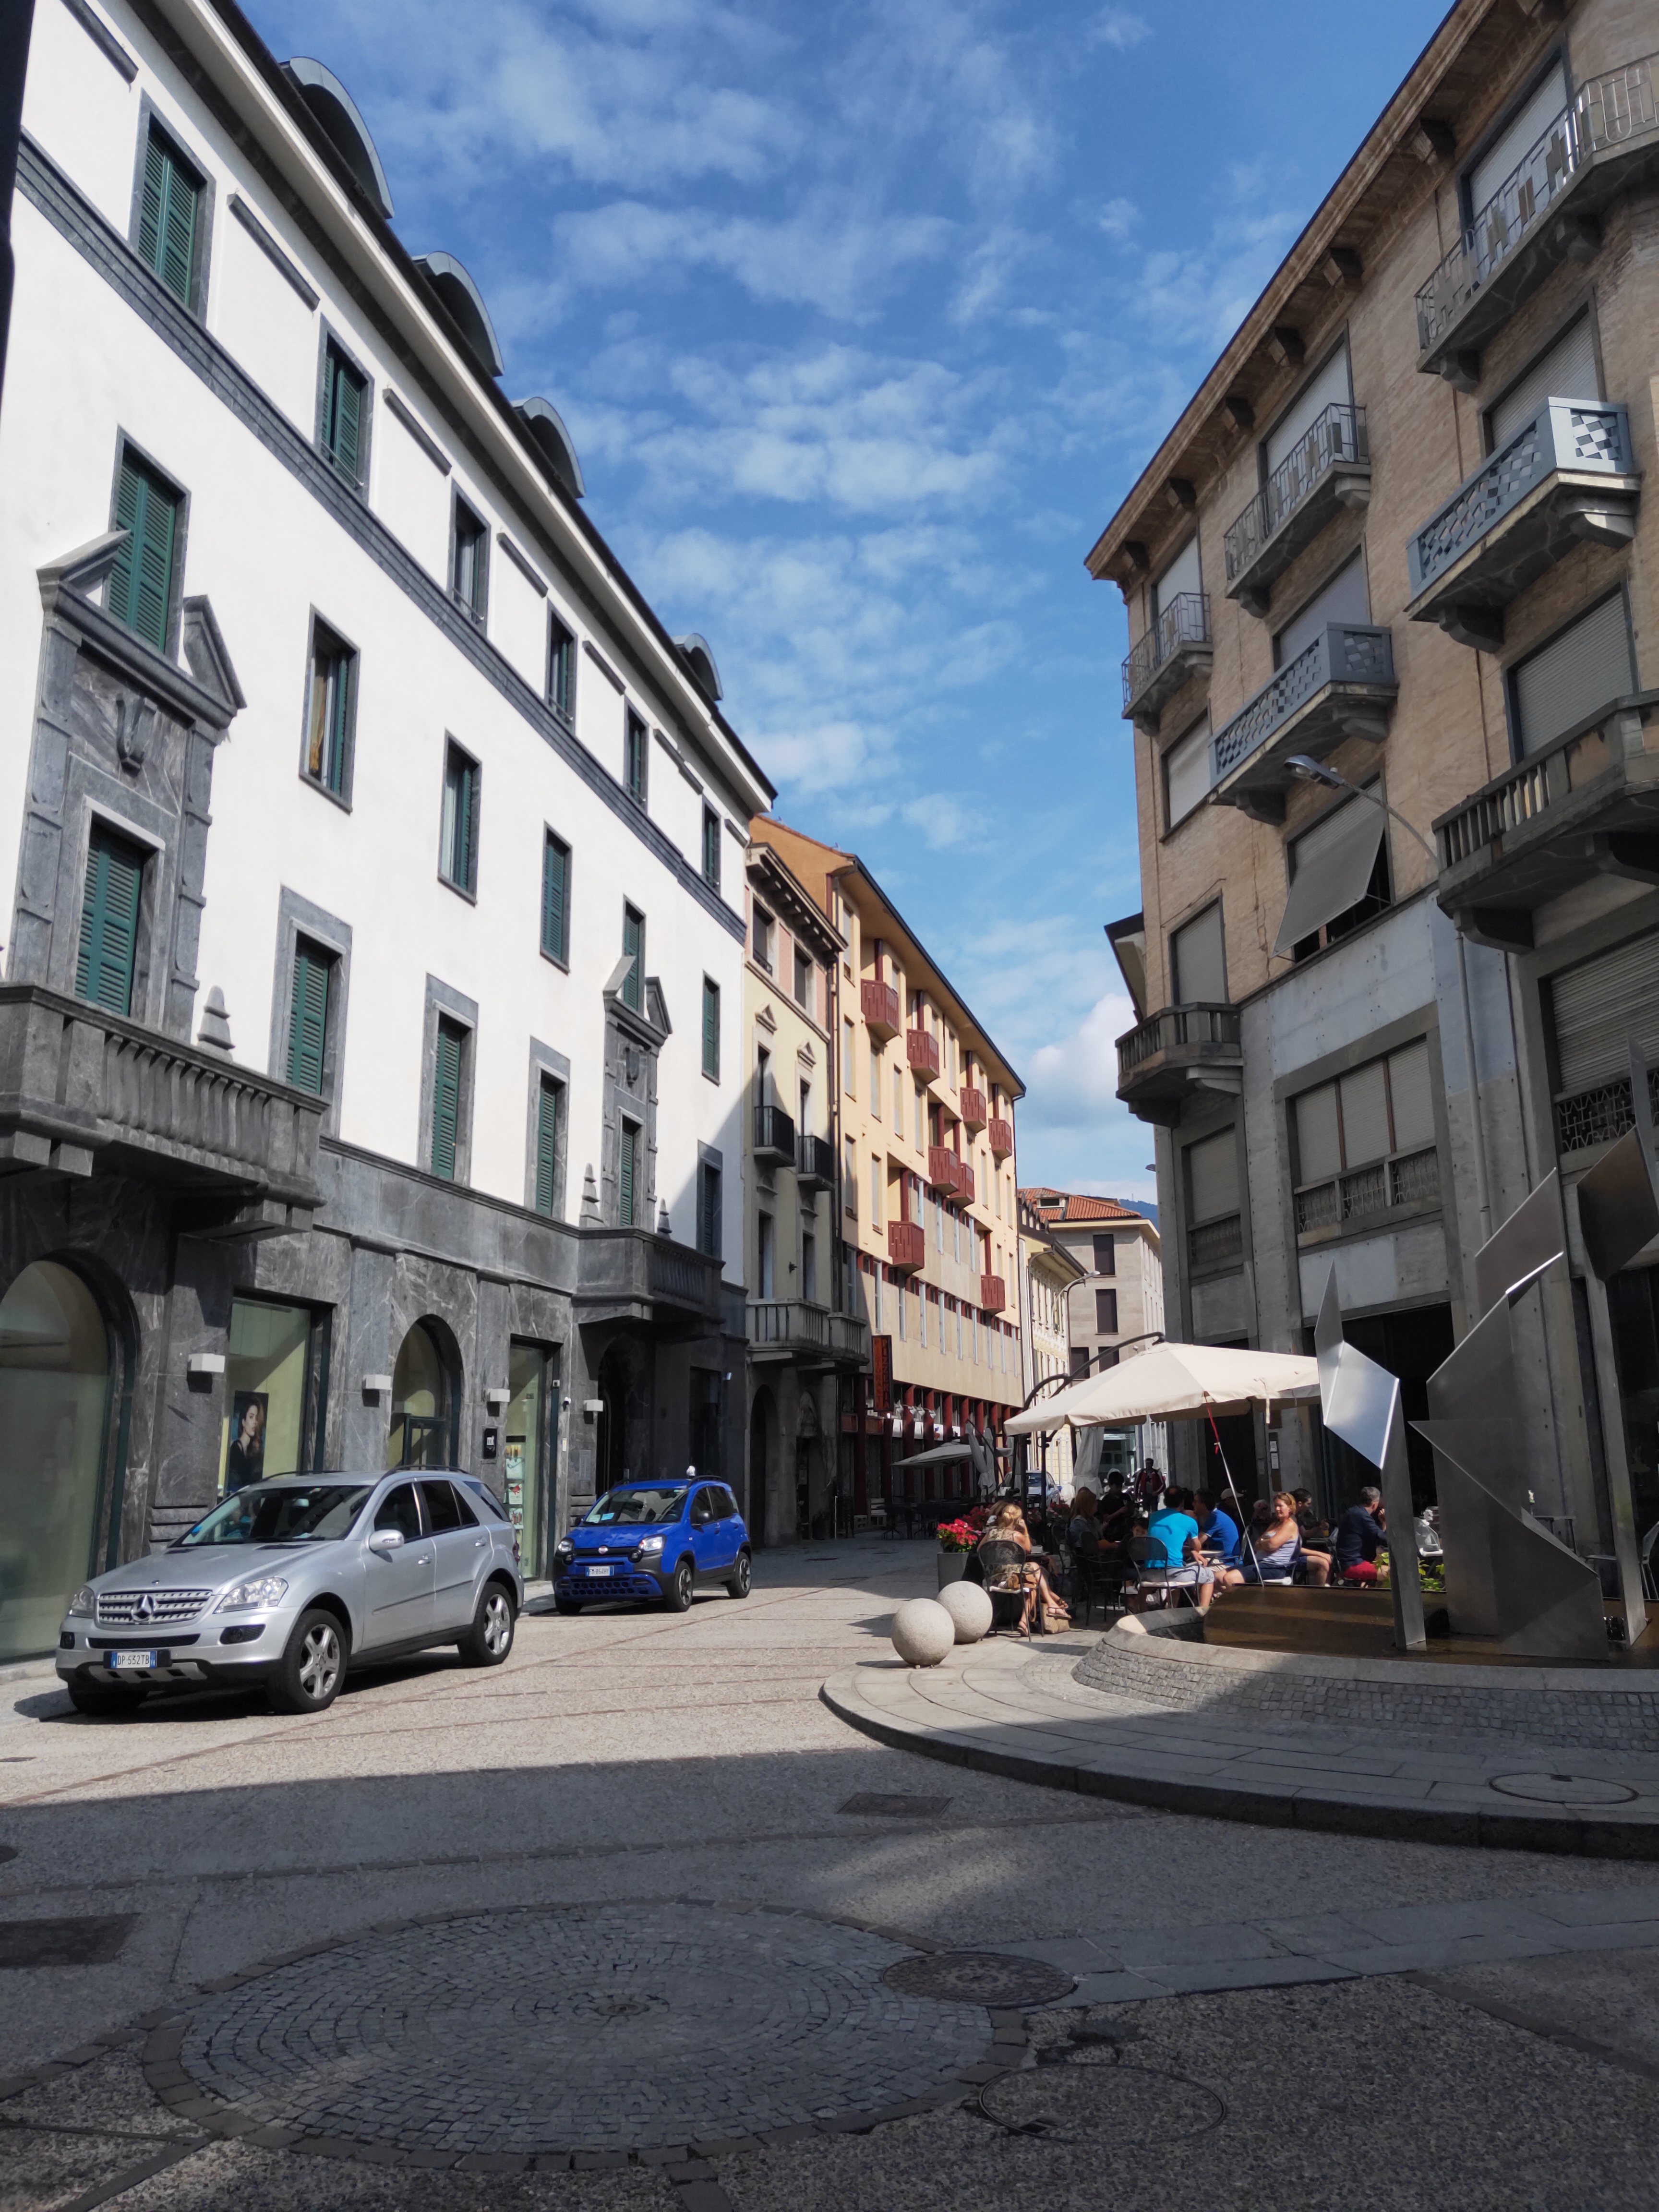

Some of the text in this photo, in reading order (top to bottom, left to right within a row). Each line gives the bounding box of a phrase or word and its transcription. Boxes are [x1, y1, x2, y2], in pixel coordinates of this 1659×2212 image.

[882, 1339, 890, 1408] PIZZERIA
[118, 1655, 149, 1665] DP 532TB
